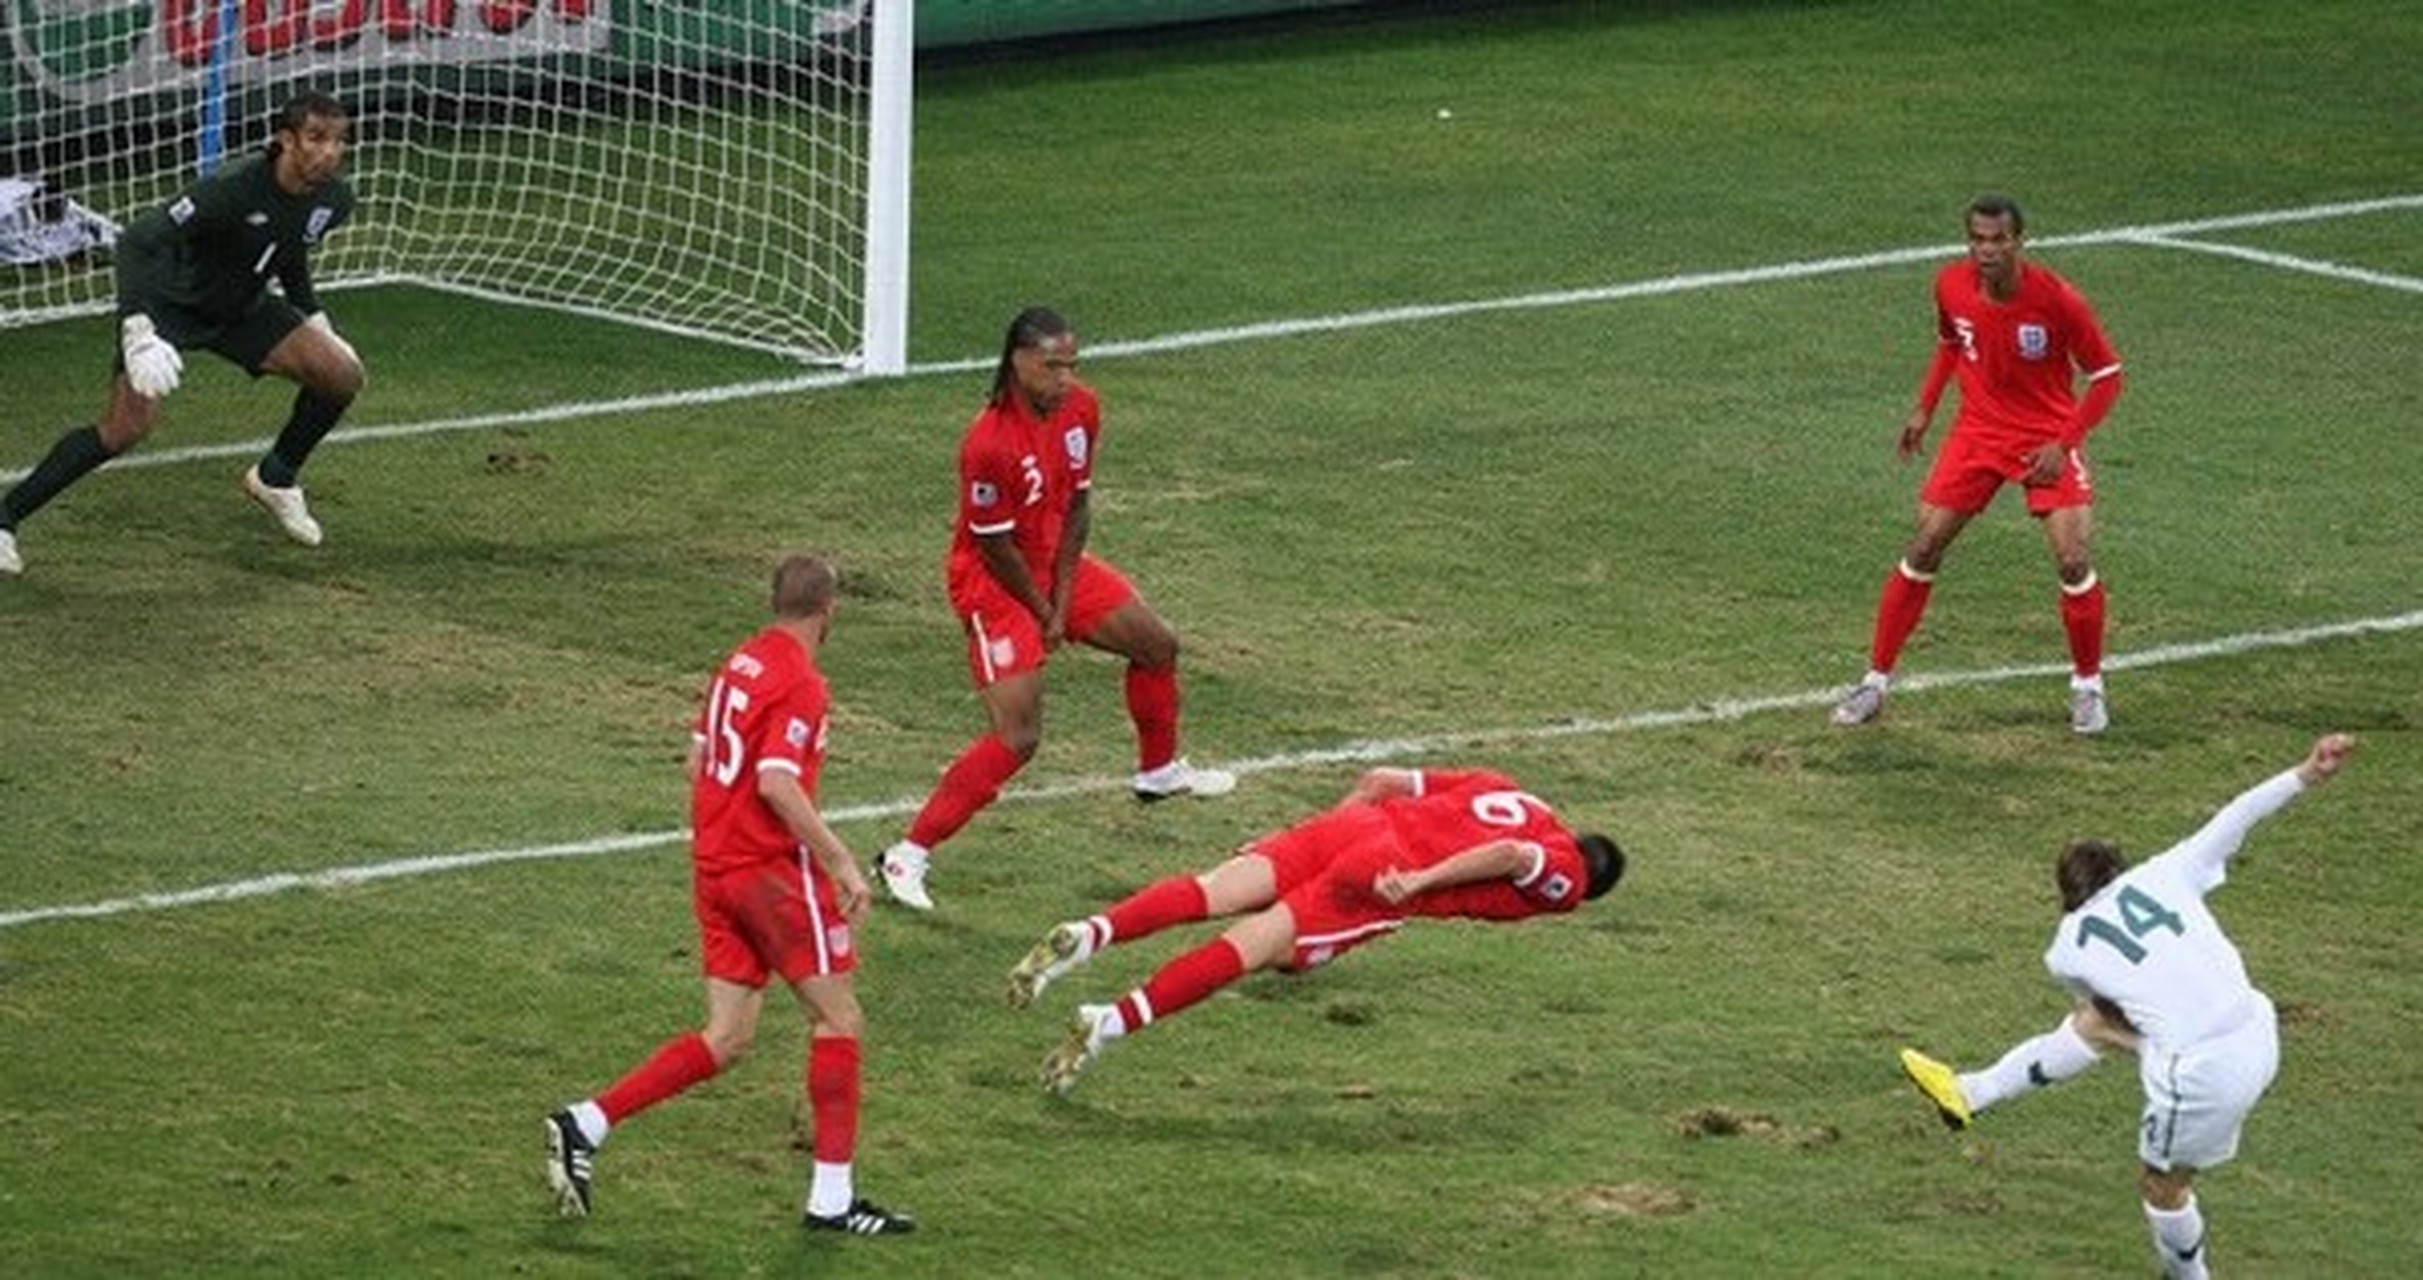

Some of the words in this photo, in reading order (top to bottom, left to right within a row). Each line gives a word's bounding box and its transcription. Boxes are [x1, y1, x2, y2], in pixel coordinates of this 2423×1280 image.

[1023, 468, 1042, 506] 2
[707, 676, 749, 786] 15
[2077, 884, 2184, 965] 14
